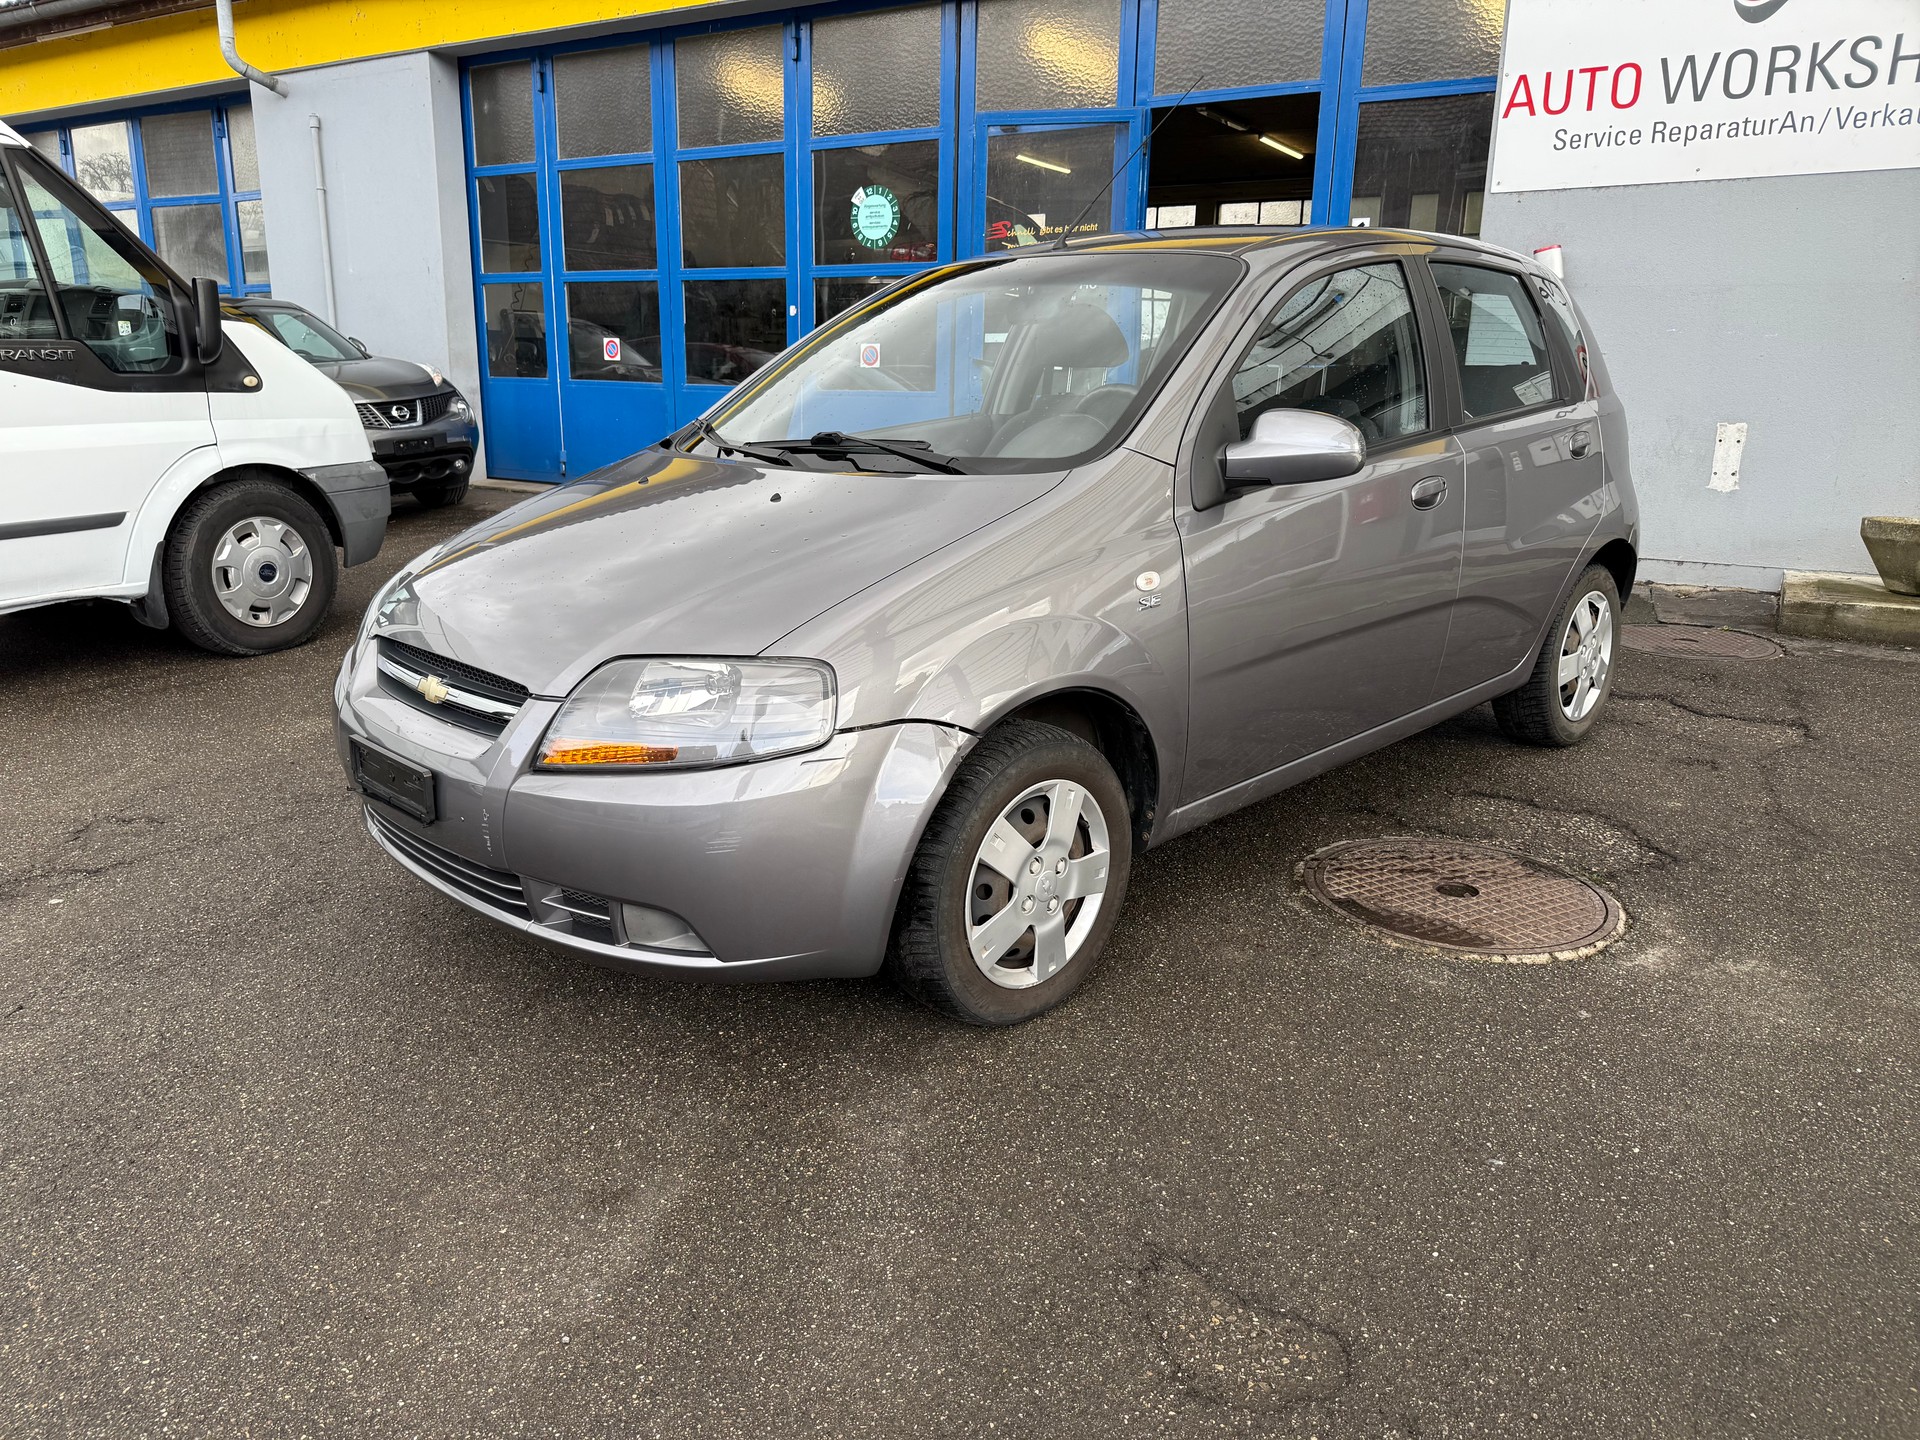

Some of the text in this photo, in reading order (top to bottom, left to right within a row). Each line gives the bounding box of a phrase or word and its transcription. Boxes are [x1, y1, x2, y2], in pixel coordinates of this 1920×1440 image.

[1502, 62, 1643, 119] AUTO
[1553, 103, 1920, 151] Service ReparaturAn/Verka
[866, 187, 873, 195] 12
[886, 193, 893, 201] 2
[1054, 226, 1063, 234] es
[1079, 222, 1098, 232] nicht
[0, 349, 76, 361] RANSIT
[1137, 594, 1162, 612] SE
